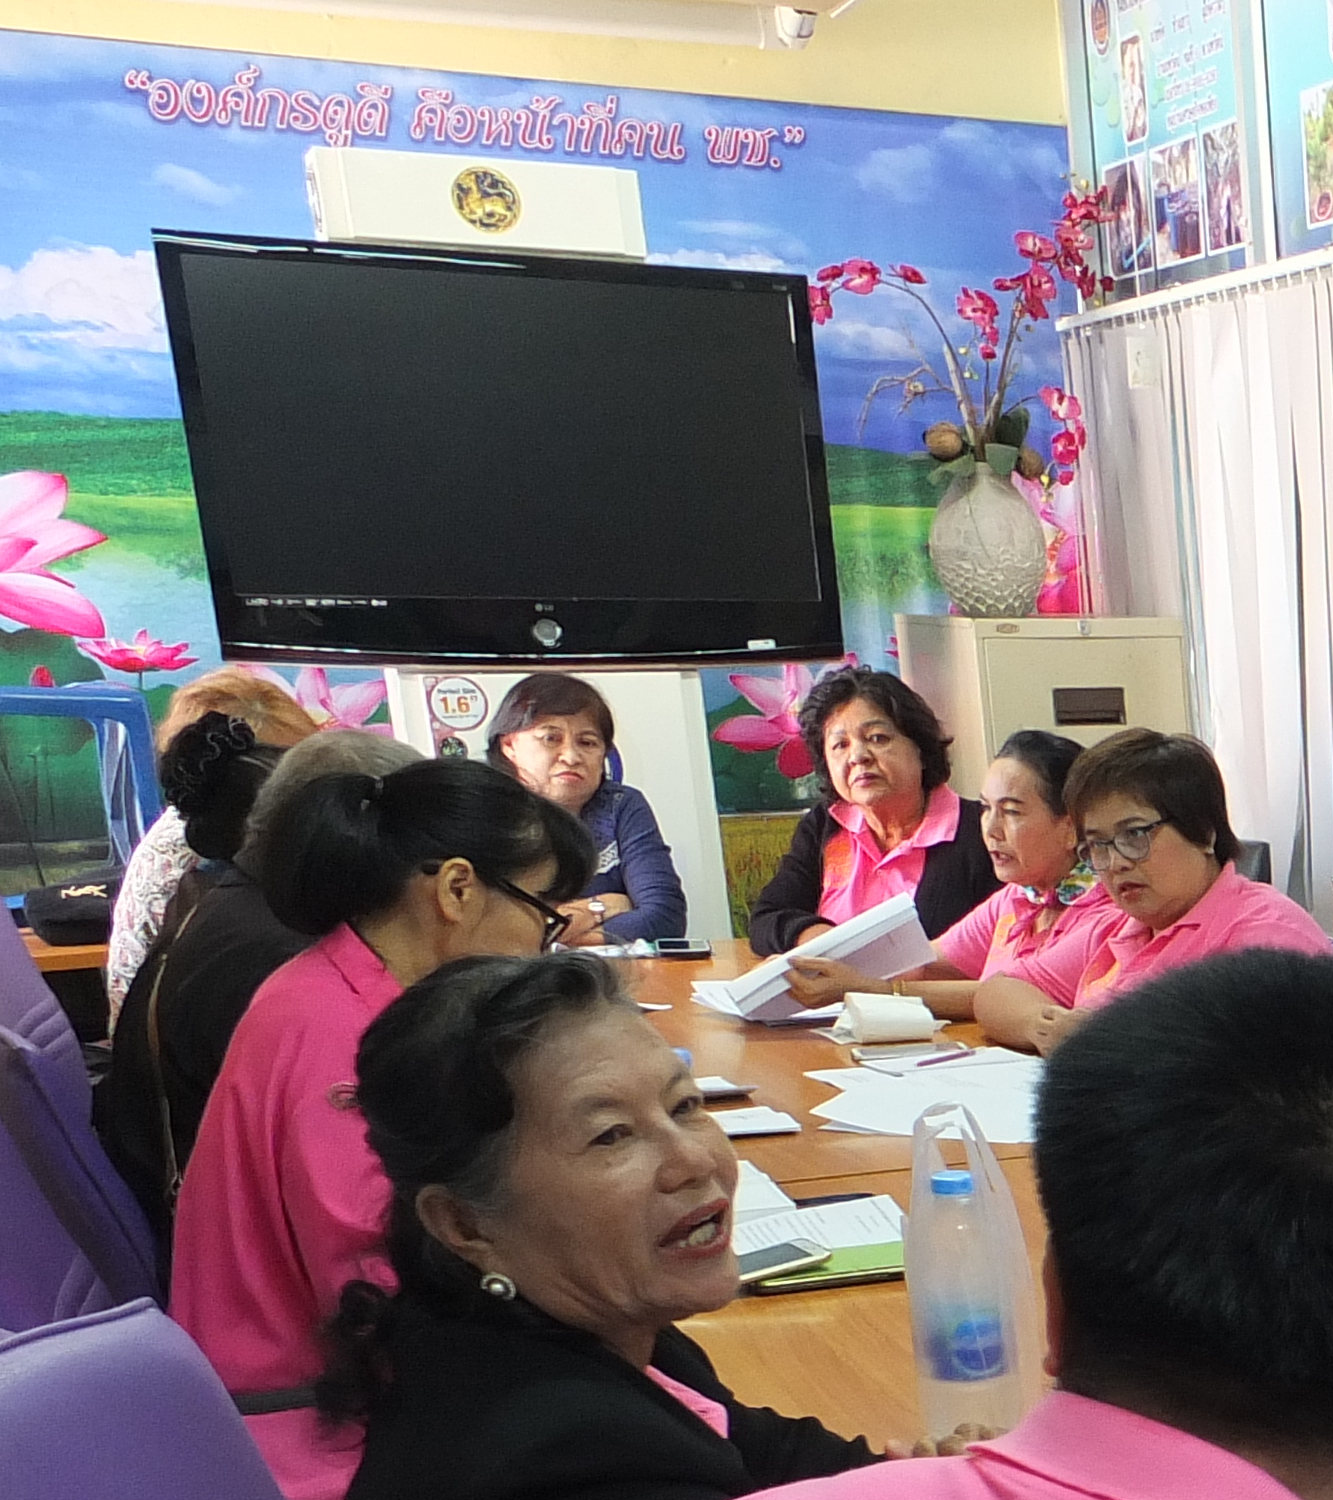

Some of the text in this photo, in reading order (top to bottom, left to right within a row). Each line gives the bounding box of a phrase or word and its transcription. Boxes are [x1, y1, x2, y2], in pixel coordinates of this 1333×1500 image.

[411, 90, 686, 159] คือหน้าที่คน
[440, 696, 470, 713] 1.6
